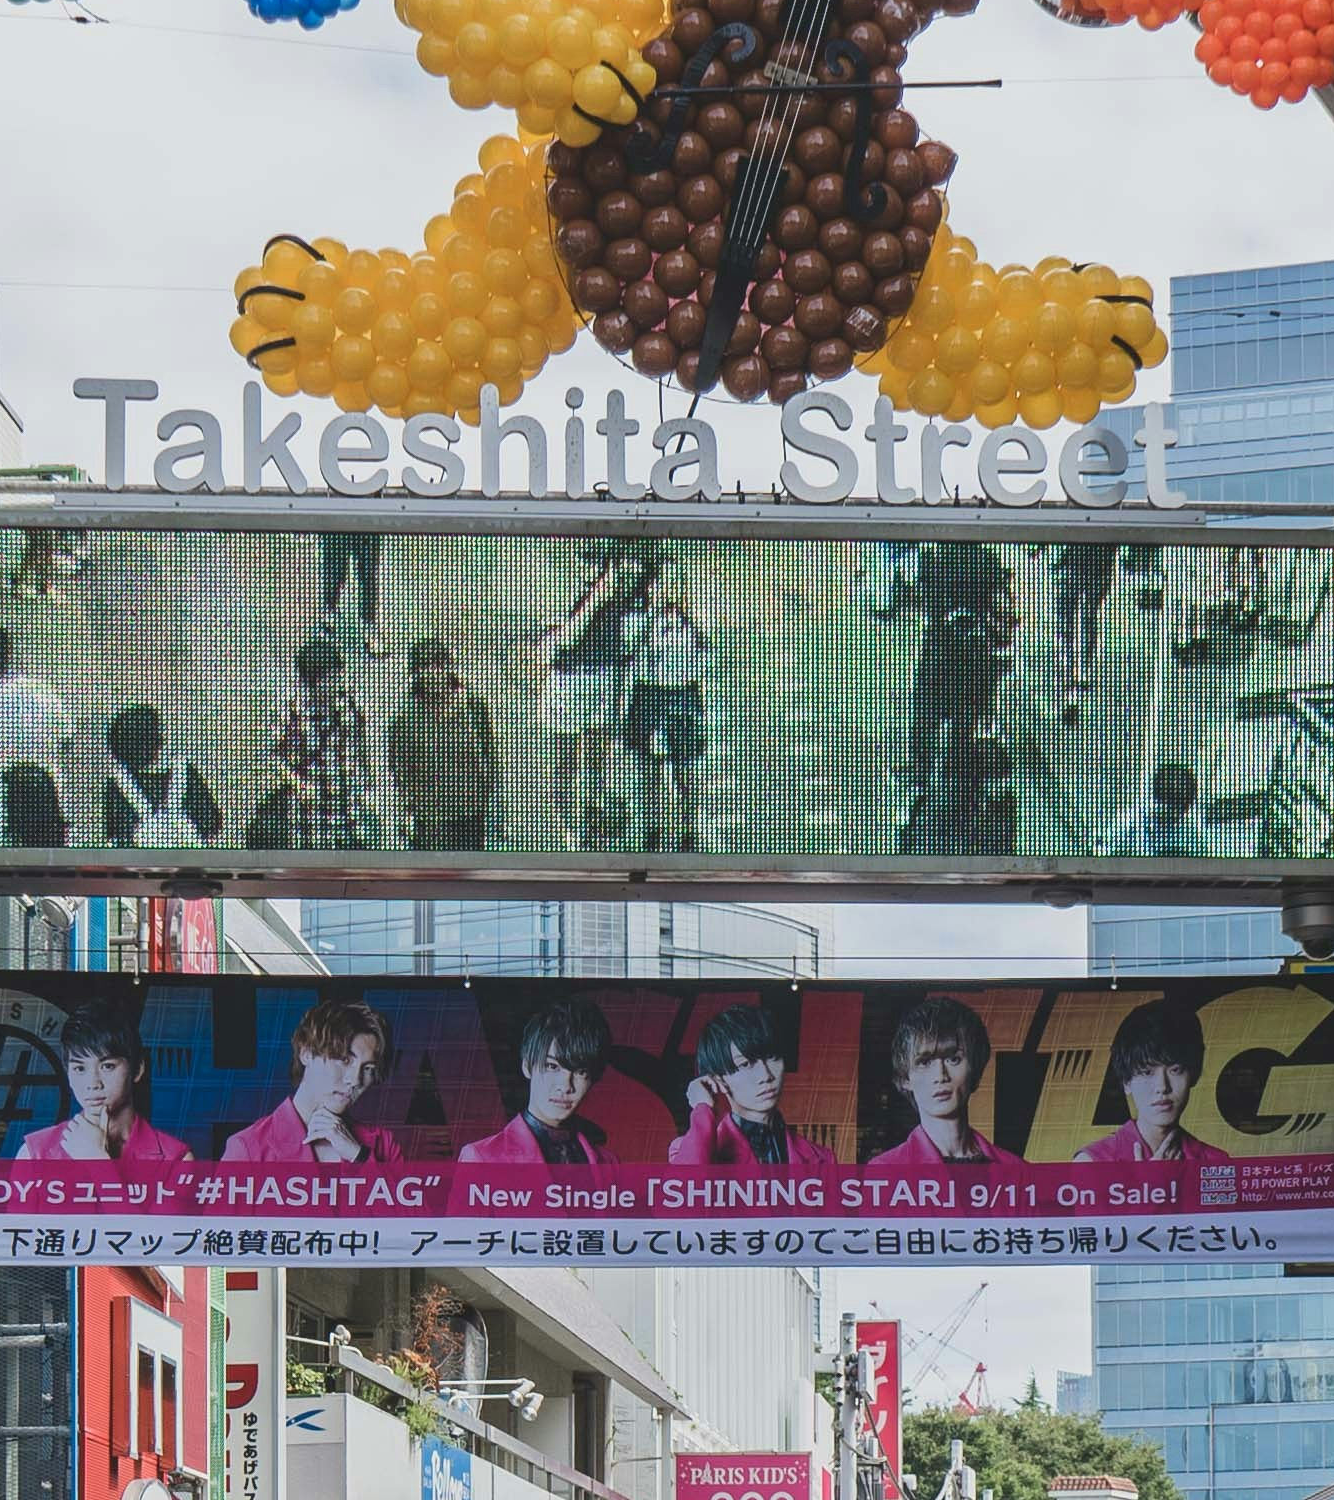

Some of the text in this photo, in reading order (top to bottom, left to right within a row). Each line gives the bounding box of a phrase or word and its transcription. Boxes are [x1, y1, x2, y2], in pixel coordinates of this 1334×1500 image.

[72, 377, 1189, 509] Takeshita Street
[468, 1182, 532, 1207] New
[545, 1184, 636, 1211] Single
[970, 1183, 1038, 1208] 9/11
[1057, 1184, 1096, 1207] On
[1108, 1181, 1178, 1205] Sale!
[690, 1461, 798, 1485] PARIS KID'S
